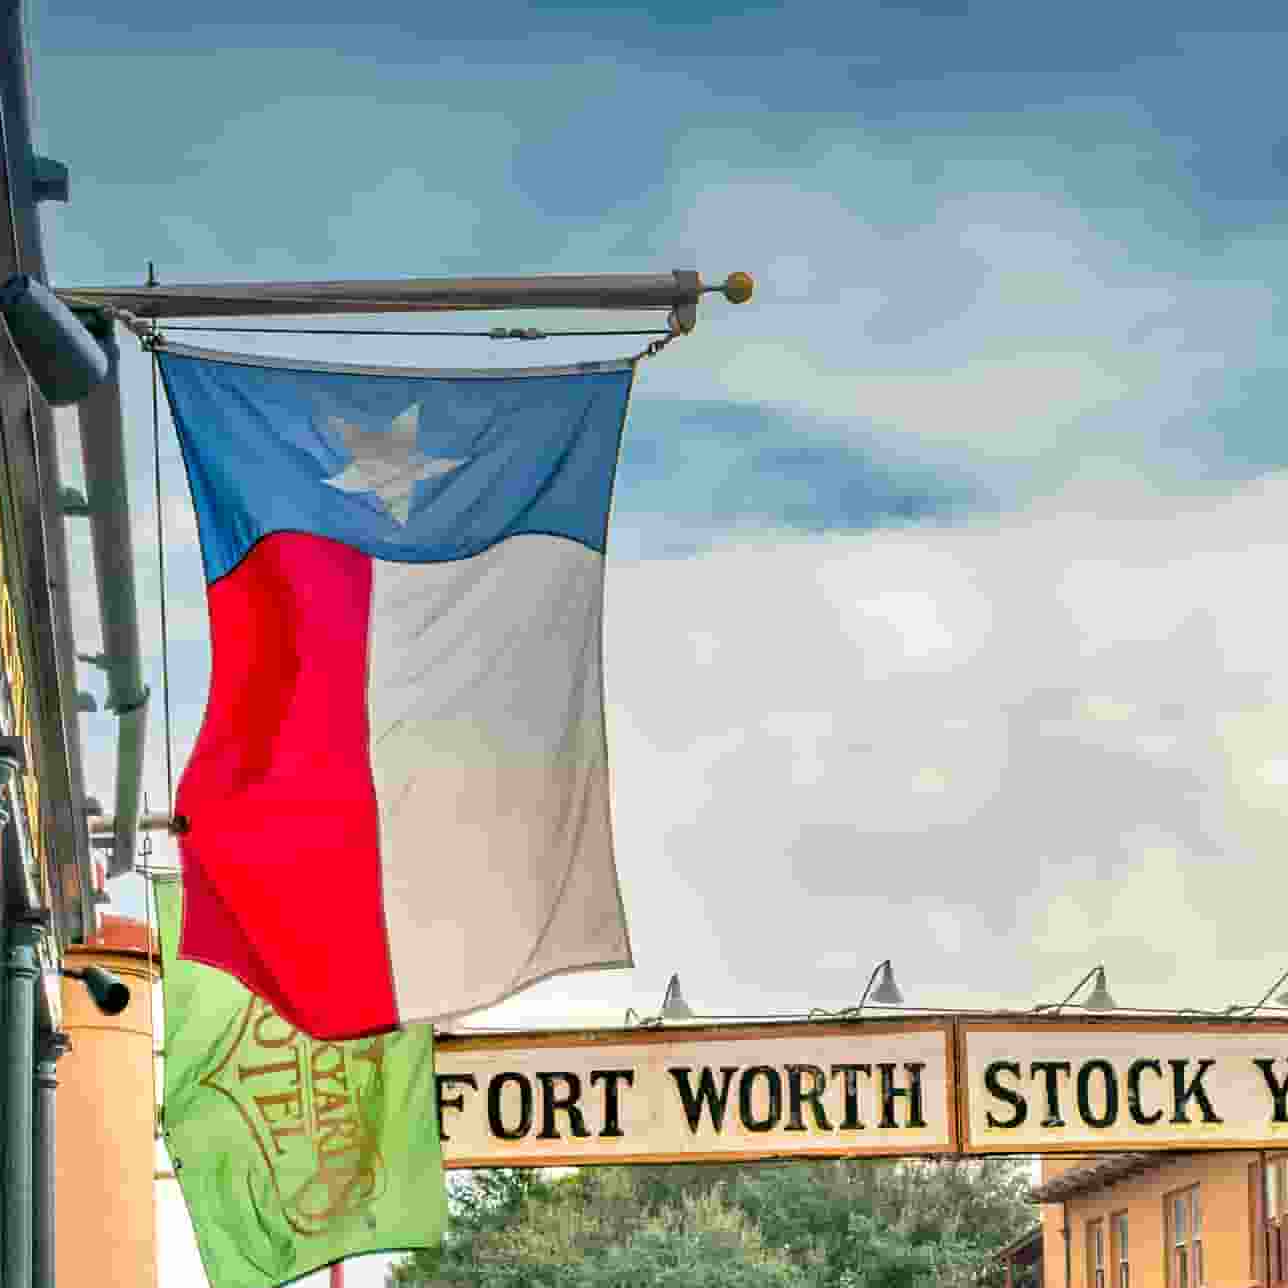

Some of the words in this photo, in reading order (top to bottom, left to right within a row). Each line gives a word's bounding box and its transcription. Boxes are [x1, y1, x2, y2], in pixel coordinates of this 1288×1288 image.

[237, 1010, 303, 1156] OTEL
[434, 1070, 634, 1142] FORT
[667, 1062, 928, 1136] WORTH
[982, 1058, 1225, 1129] STOCK
